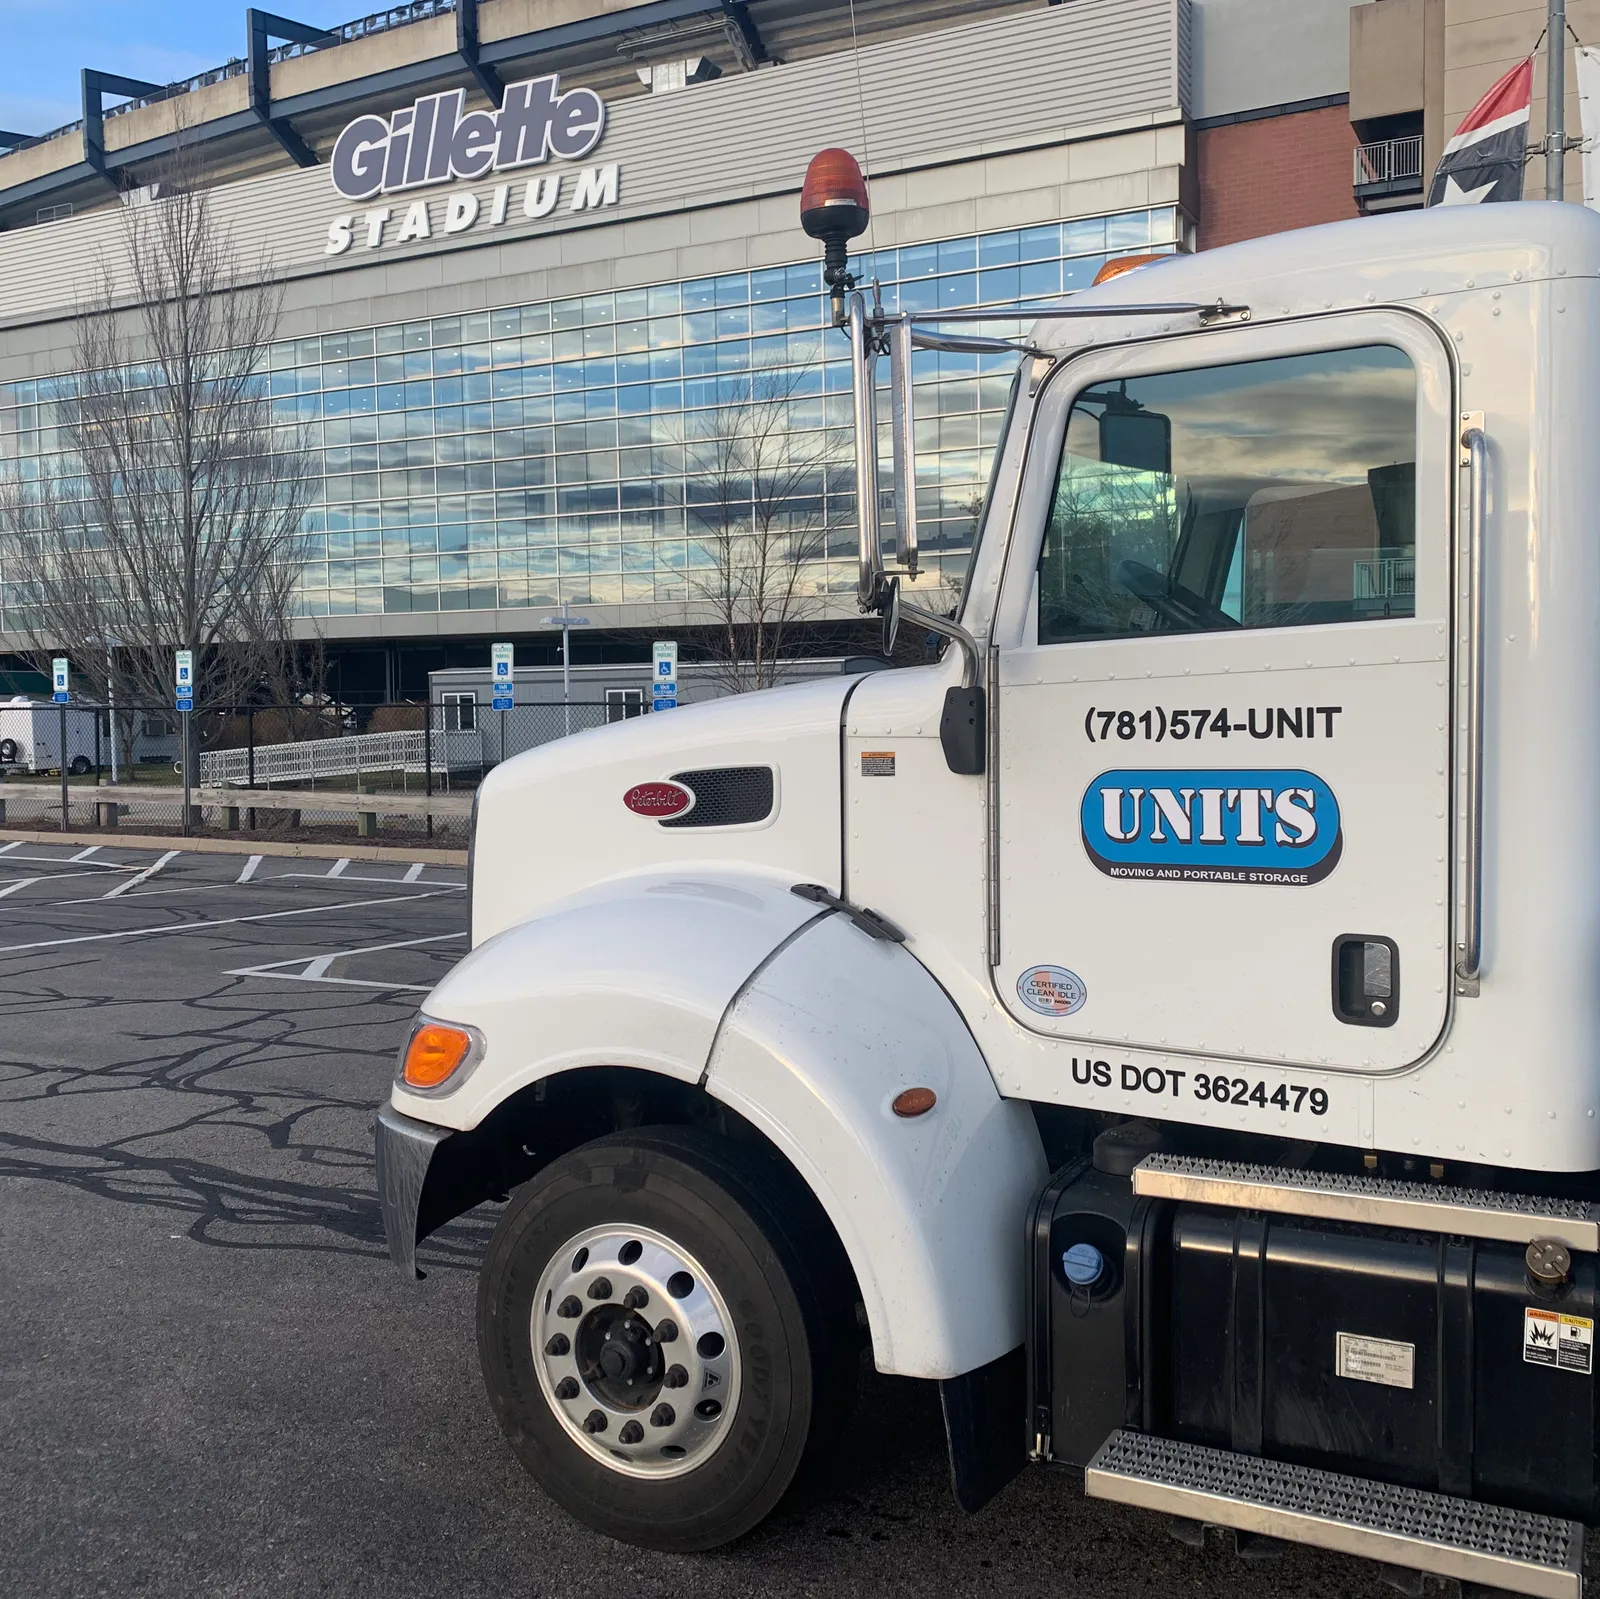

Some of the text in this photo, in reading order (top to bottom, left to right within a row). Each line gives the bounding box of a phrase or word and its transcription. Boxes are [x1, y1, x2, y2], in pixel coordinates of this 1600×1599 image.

[331, 73, 606, 201] Gillette
[324, 163, 620, 255] STADIUM
[1084, 706, 1342, 743] (781)574-UNIT
[630, 788, 683, 807] Peterbilt
[1099, 788, 1318, 848] UNITS
[1110, 867, 1308, 883] MOVING AND PORTABLE STORAGE
[1026, 988, 1077, 999] CLEAN IDLE
[1030, 980, 1072, 990] CERTIFIED
[1072, 1058, 1329, 1116] US DOT 3624479
[1564, 1318, 1588, 1326] CAUTION
